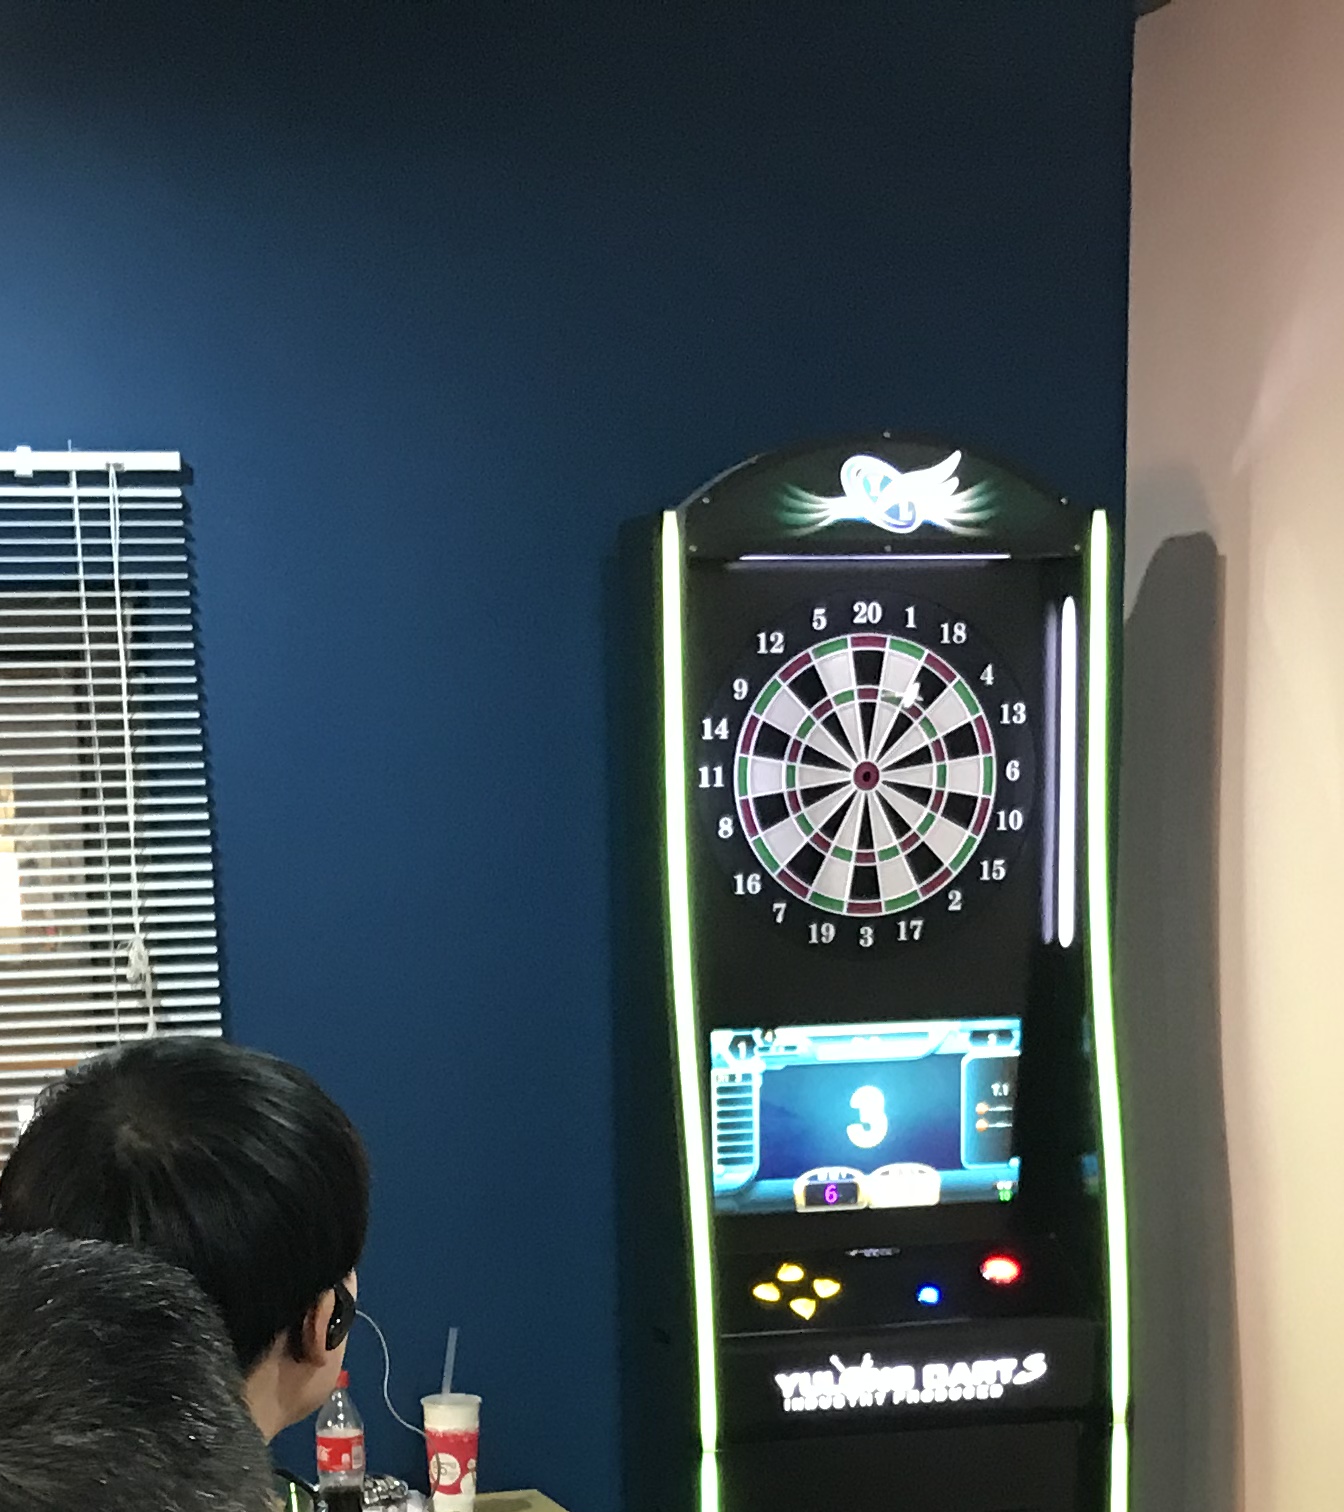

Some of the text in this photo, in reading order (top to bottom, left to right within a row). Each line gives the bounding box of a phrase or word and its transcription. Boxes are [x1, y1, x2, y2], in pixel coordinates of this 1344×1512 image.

[812, 608, 828, 631] 5
[853, 601, 883, 624] 20
[905, 606, 917, 629] 1
[757, 631, 785, 655] 12
[940, 622, 967, 645] 18
[980, 663, 995, 686] 4
[732, 678, 749, 701] 9
[999, 702, 1027, 725] 13
[701, 717, 730, 741] 14
[698, 765, 725, 789] 11
[1005, 759, 1021, 782] 6
[717, 816, 734, 839] 8
[997, 809, 1024, 831] 10
[979, 859, 1007, 881] 15
[733, 872, 762, 895] 16
[947, 889, 962, 911] 2
[772, 902, 787, 924] 7
[808, 922, 836, 944] 19
[859, 926, 874, 948] 3
[897, 919, 924, 941] 17
[846, 1085, 888, 1149] 3
[824, 1184, 839, 1203] 6
